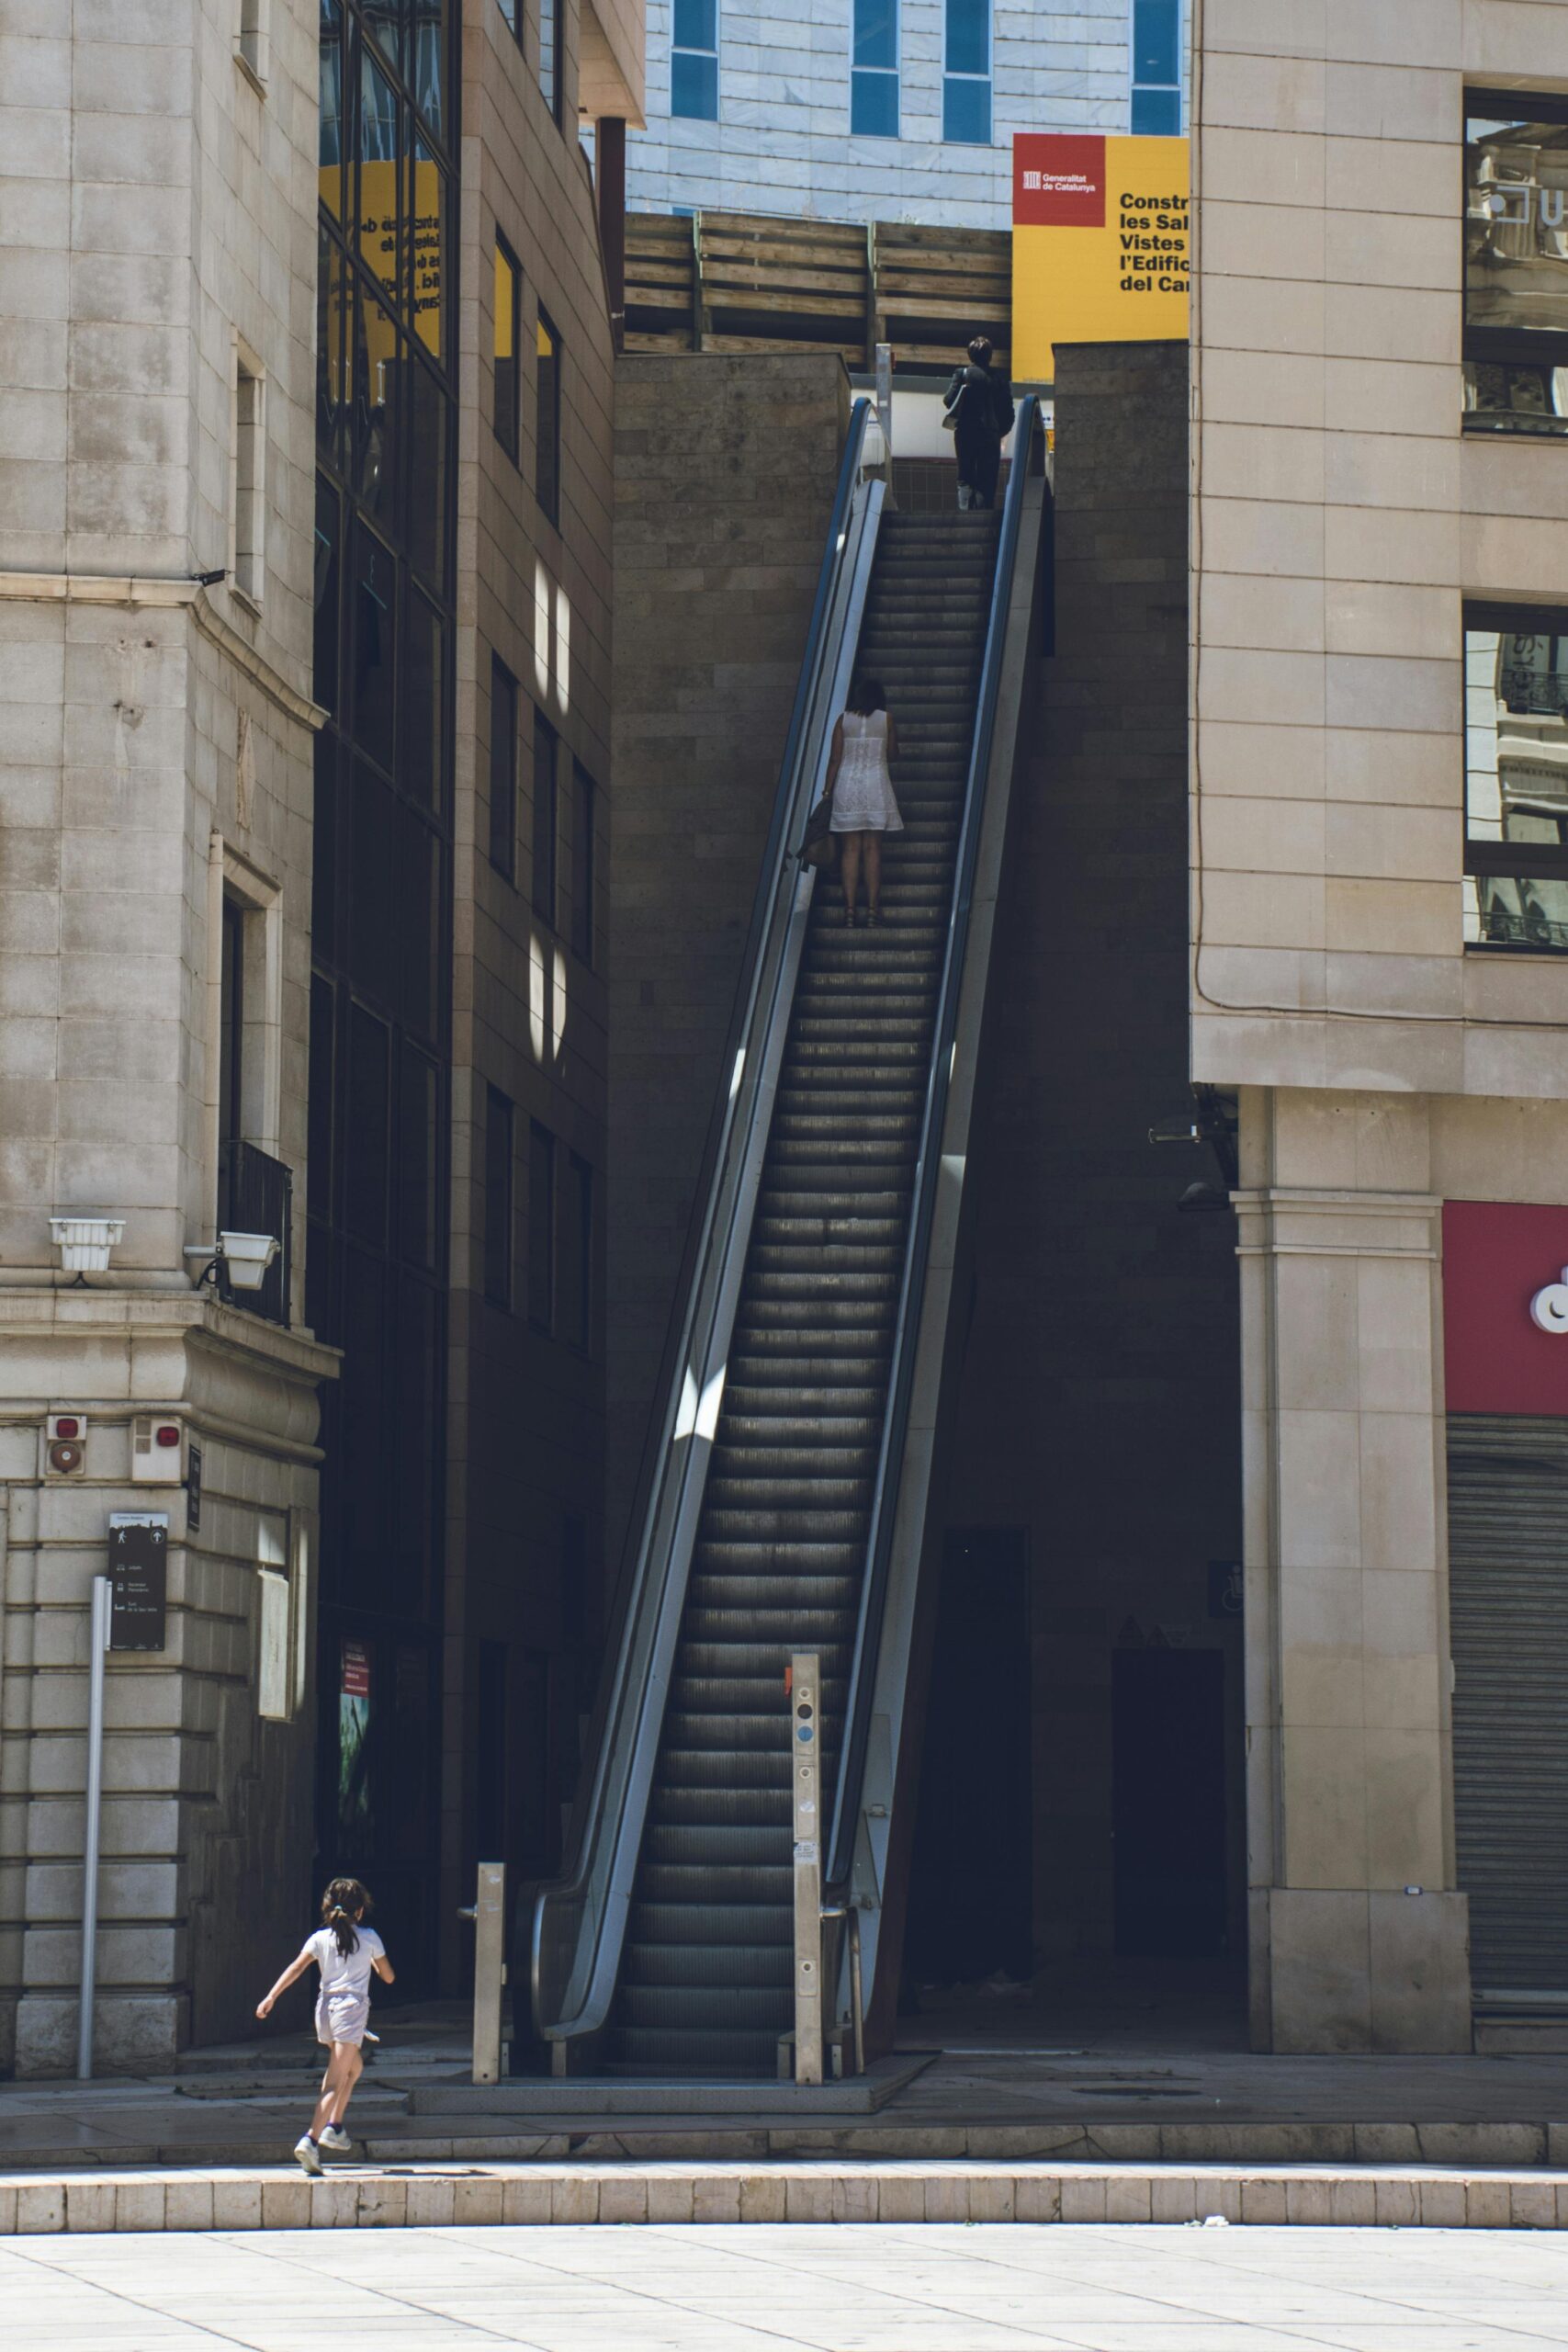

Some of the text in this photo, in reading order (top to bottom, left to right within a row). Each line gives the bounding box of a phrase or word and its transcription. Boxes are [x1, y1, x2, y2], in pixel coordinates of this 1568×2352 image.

[1043, 174, 1087, 183] Generalitat
[1055, 183, 1096, 193] Catalunya
[1120, 213, 1189, 231] les Sal
[1120, 234, 1185, 251] Vistes
[1120, 275, 1153, 292] del
